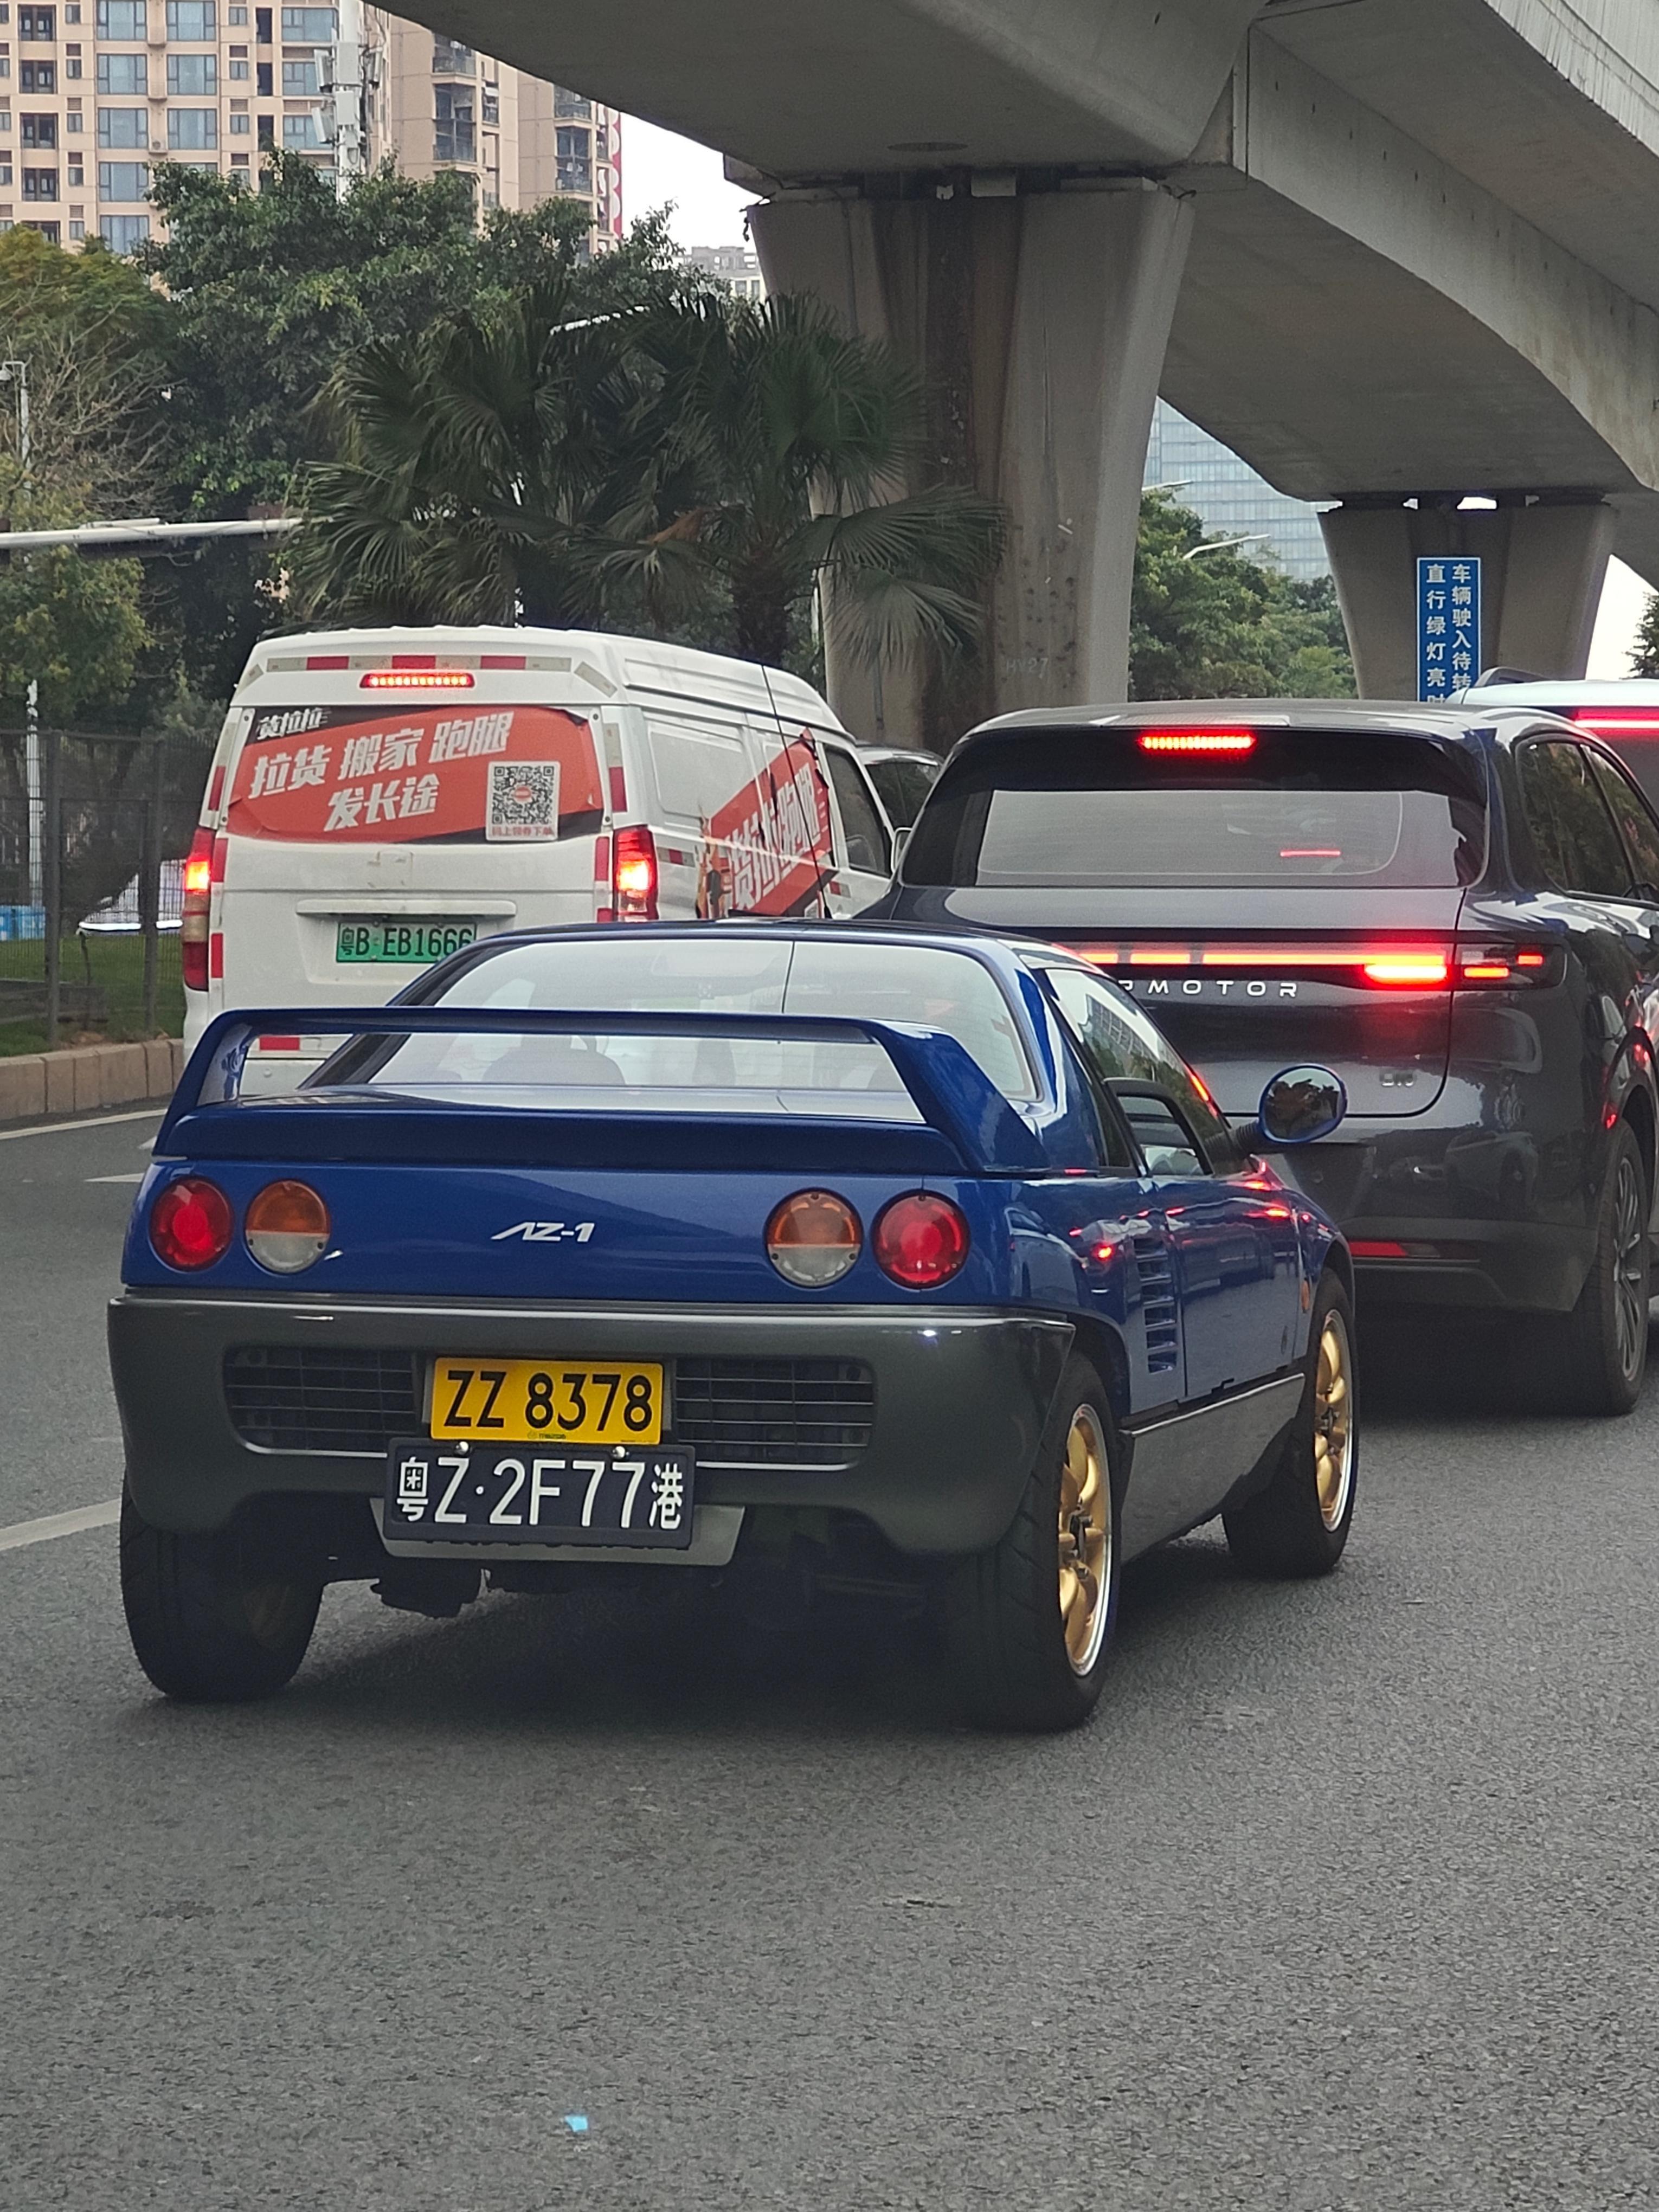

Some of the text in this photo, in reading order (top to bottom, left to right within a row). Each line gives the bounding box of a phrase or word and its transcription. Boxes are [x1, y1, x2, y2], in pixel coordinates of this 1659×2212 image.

[256, 707, 324, 740] 货拉拉
[248, 711, 514, 799] 拉货 搬家 跑腿
[324, 774, 440, 832] 发长途
[491, 1222, 595, 1242] AZ-1
[443, 1369, 652, 1431] ZZ 8378
